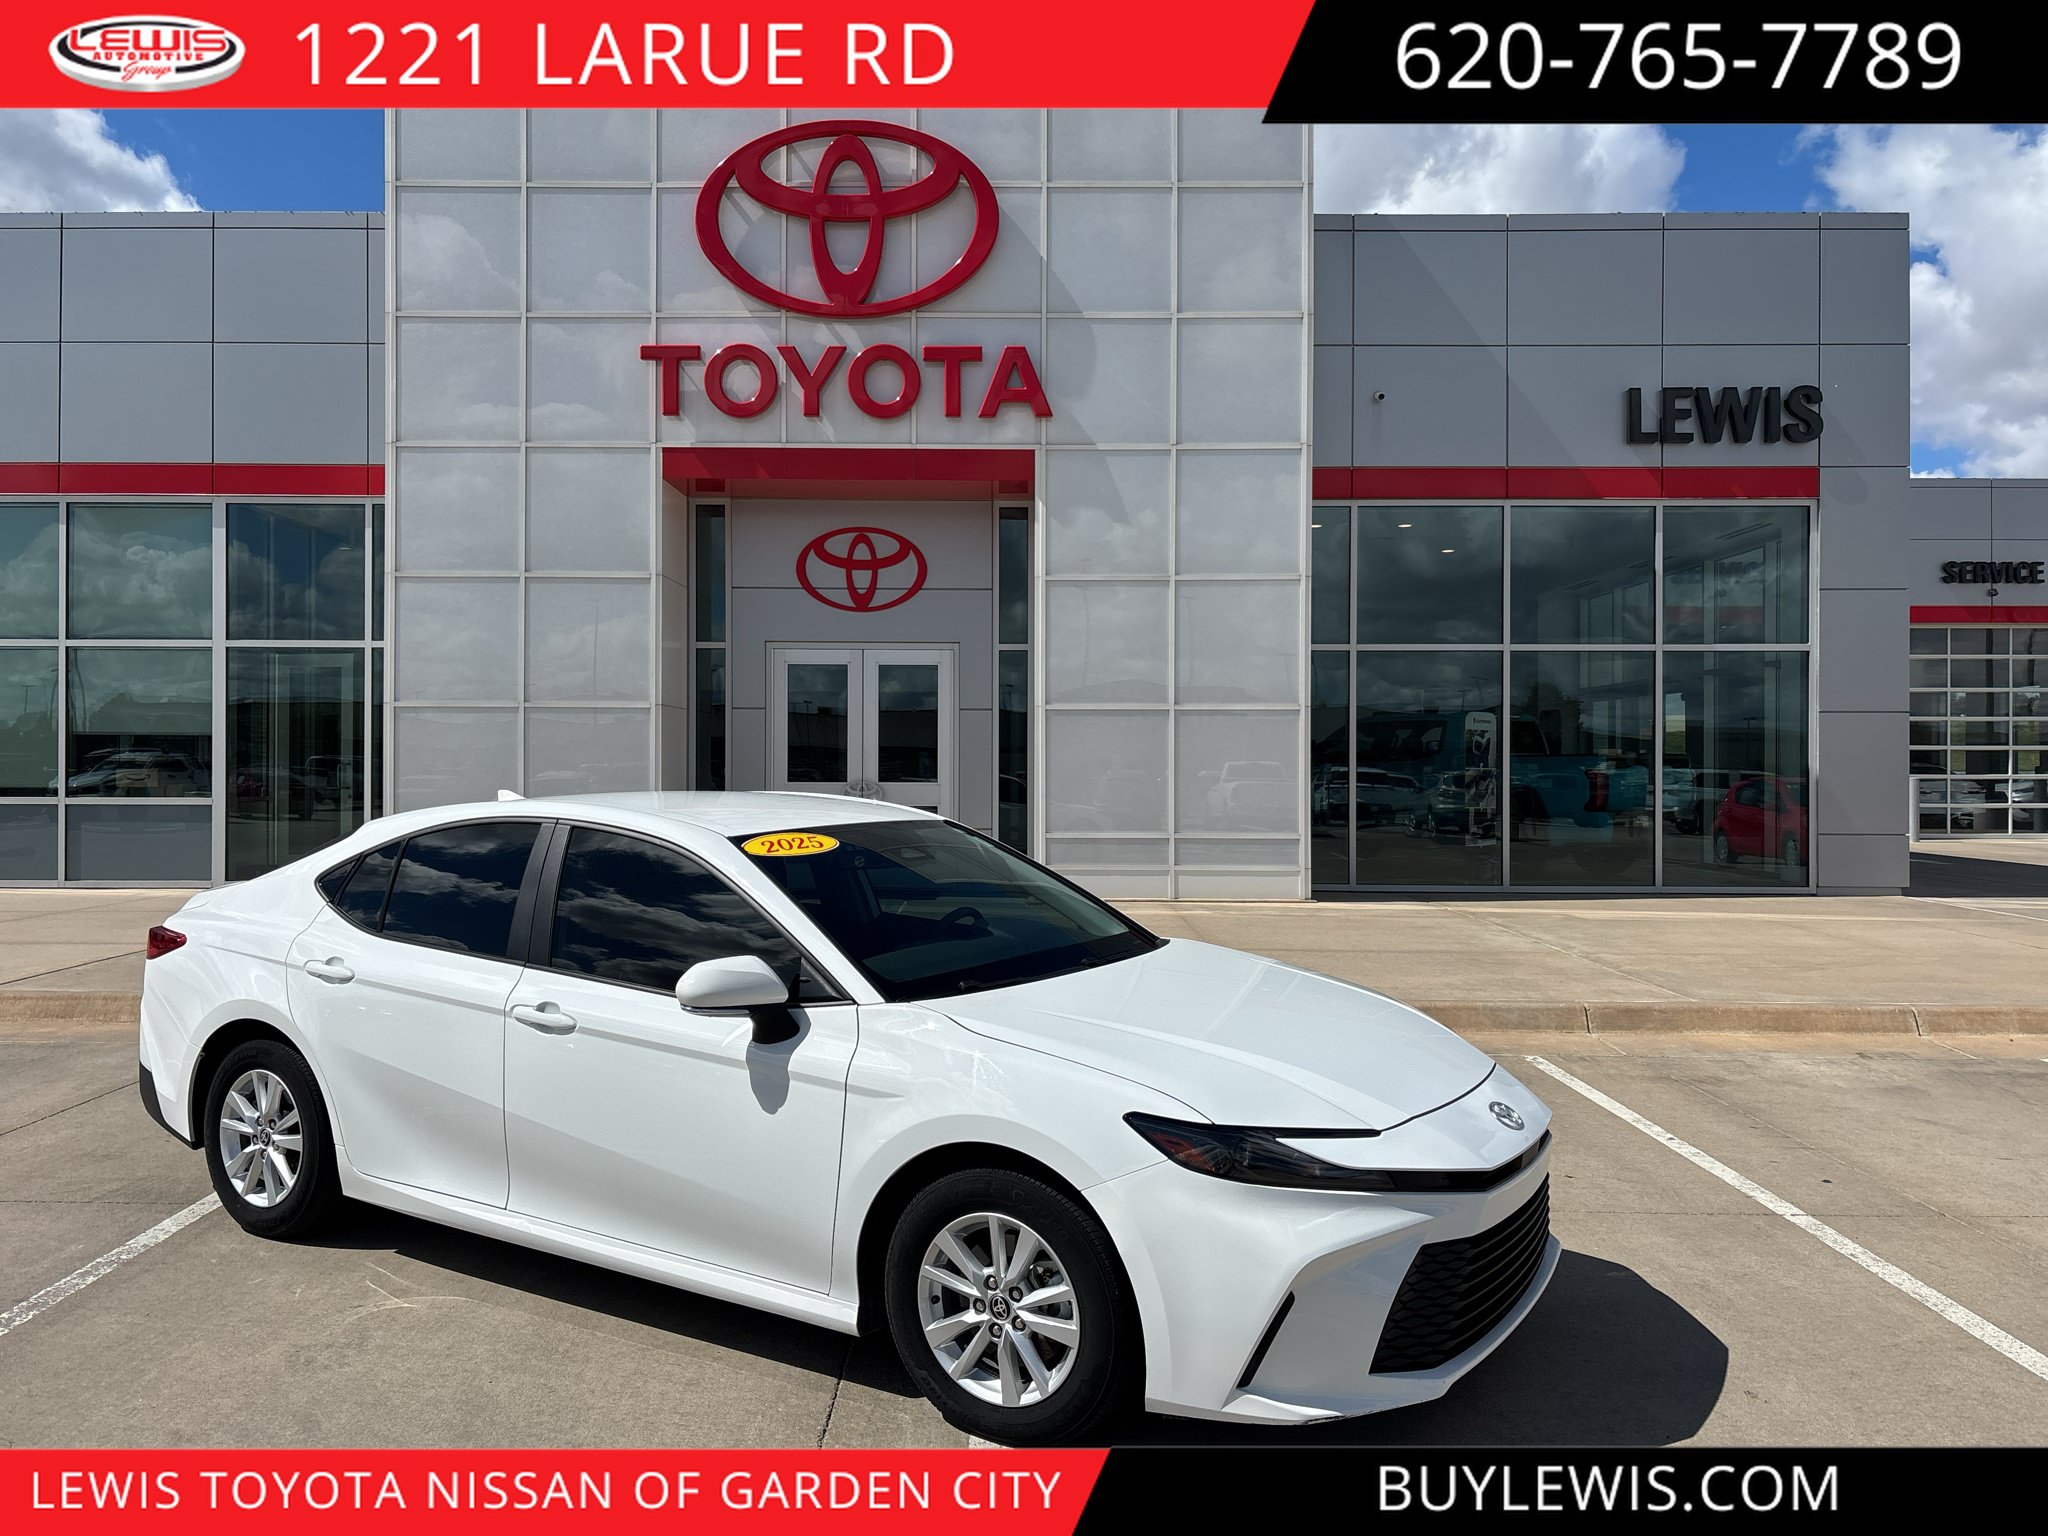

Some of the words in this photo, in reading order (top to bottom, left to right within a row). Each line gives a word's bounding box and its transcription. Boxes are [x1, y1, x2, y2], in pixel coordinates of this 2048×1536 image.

[640, 343, 1053, 418] TOYOTA
[1625, 385, 1824, 444] LEWIS
[1941, 561, 2045, 584] SERVICE
[761, 836, 824, 853] 2025
